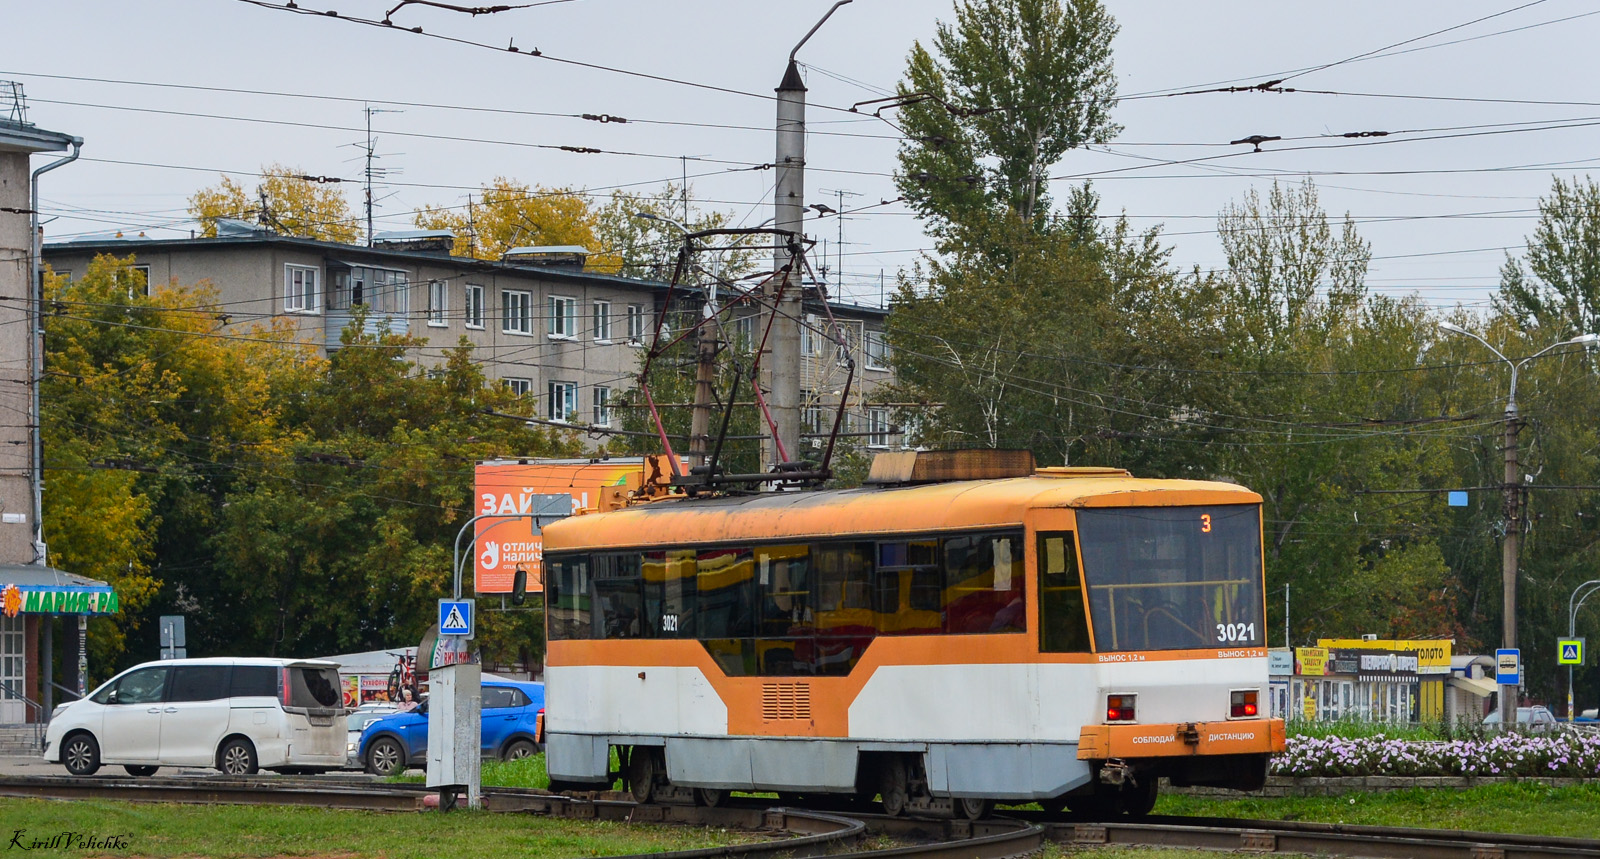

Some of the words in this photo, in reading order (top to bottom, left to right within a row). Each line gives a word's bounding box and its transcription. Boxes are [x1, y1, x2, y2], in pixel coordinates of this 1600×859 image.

[481, 487, 588, 515] ЗАЙЫ
[1201, 514, 1211, 532] 3
[25, 591, 118, 612] МАРИЯ-РА
[662, 614, 678, 631] 3021
[1216, 622, 1255, 642] 3021
[444, 651, 471, 665] ВИТМИН
[1098, 654, 1127, 662] ВЫНОС
[1128, 654, 1138, 662] 1,2
[1217, 650, 1245, 658] ВЫНОС
[1247, 650, 1257, 658] 1,2
[1412, 647, 1444, 660] ОЛОТО
[1132, 734, 1175, 744] СОБЛЮДАЙ
[1208, 732, 1255, 742] ДИСТАНЦИЮ
